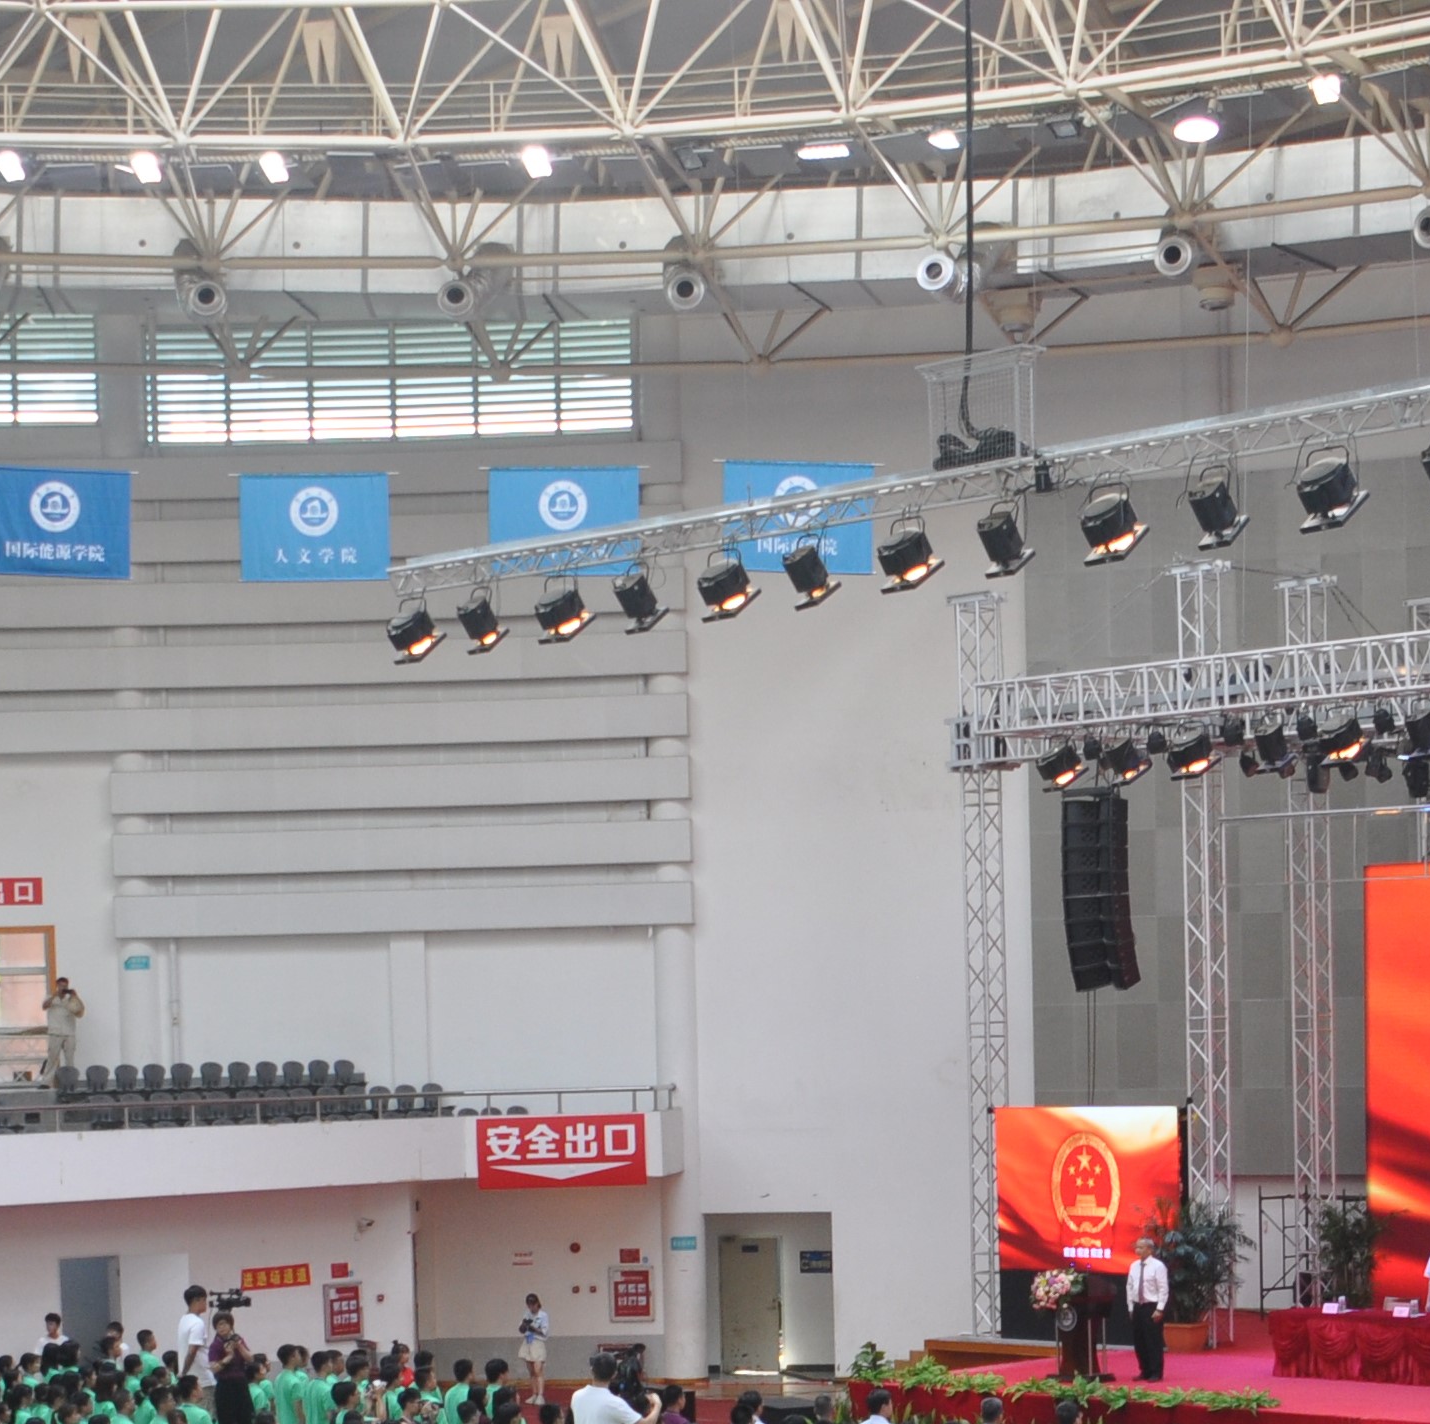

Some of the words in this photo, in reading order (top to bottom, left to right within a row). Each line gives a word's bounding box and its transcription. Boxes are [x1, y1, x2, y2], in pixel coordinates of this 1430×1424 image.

[5, 540, 106, 563] 国际能源学院
[274, 547, 358, 565] 人文学院
[486, 1122, 636, 1161] 安全出口
